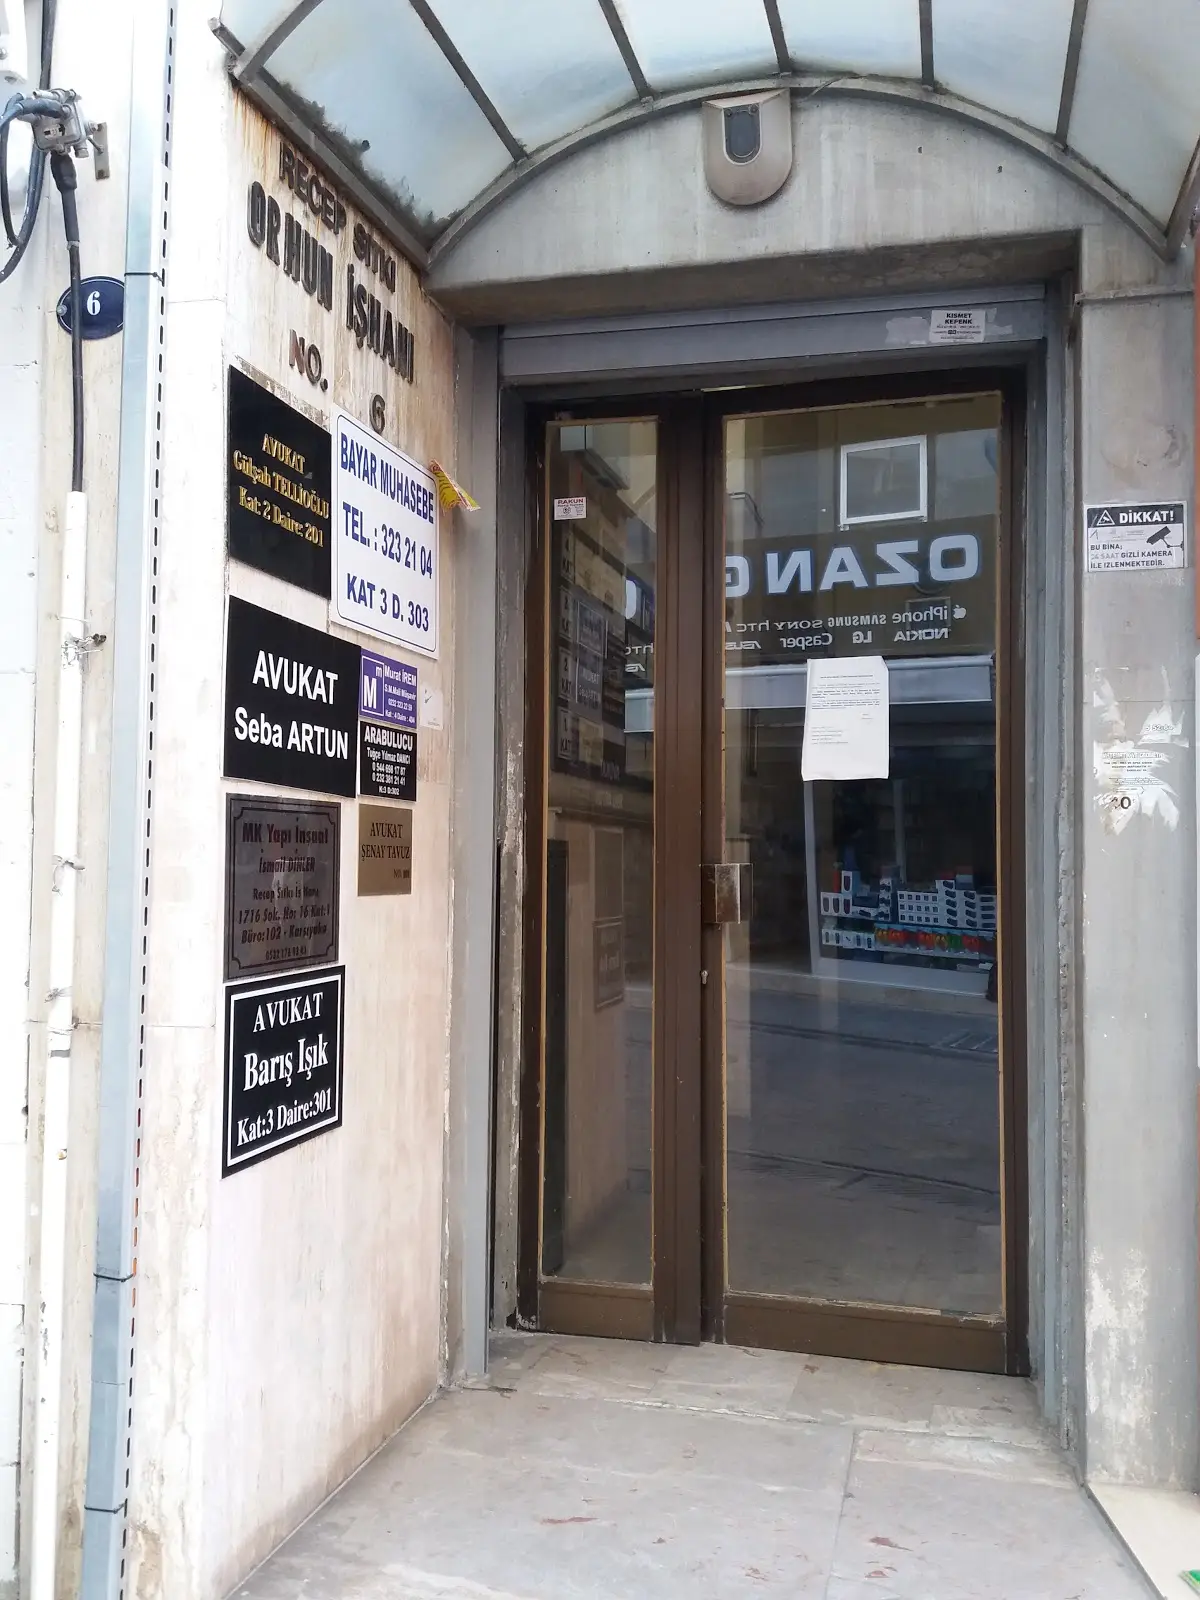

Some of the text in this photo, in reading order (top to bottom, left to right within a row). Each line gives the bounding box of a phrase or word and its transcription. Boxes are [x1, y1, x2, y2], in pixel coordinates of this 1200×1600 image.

[279, 141, 347, 235] RECEP
[87, 290, 100, 316] 6
[247, 181, 414, 384] ORHUN İŞHANI
[289, 329, 386, 434] NO. 6
[262, 433, 306, 474] AVUKAT
[233, 450, 329, 519] Gülşah TELLİOĞLU
[340, 432, 434, 524] BAYAR MUHASEBE
[305, 525, 324, 548] 201
[1119, 510, 1174, 524] DİKKAT!
[381, 524, 401, 562] 323
[404, 536, 416, 571] 21
[420, 545, 432, 579] 04
[346, 573, 430, 632] KAT 3 D. 303
[252, 650, 338, 705] AVUKAT
[364, 674, 377, 709] M
[384, 665, 401, 682] Murat
[234, 706, 348, 760] Seba ARTUN
[364, 726, 413, 751] ARABULUCU
[242, 822, 262, 843] MK
[267, 824, 292, 848] Yapı
[370, 822, 403, 838] AVUKAT
[362, 844, 386, 861] ŞENAY
[253, 887, 275, 903] Recep
[239, 909, 261, 925] 1716
[253, 992, 324, 1033] AVUKAT
[243, 1034, 328, 1092] Barış Işık
[236, 1088, 332, 1146] Kat:3 Daire:301
